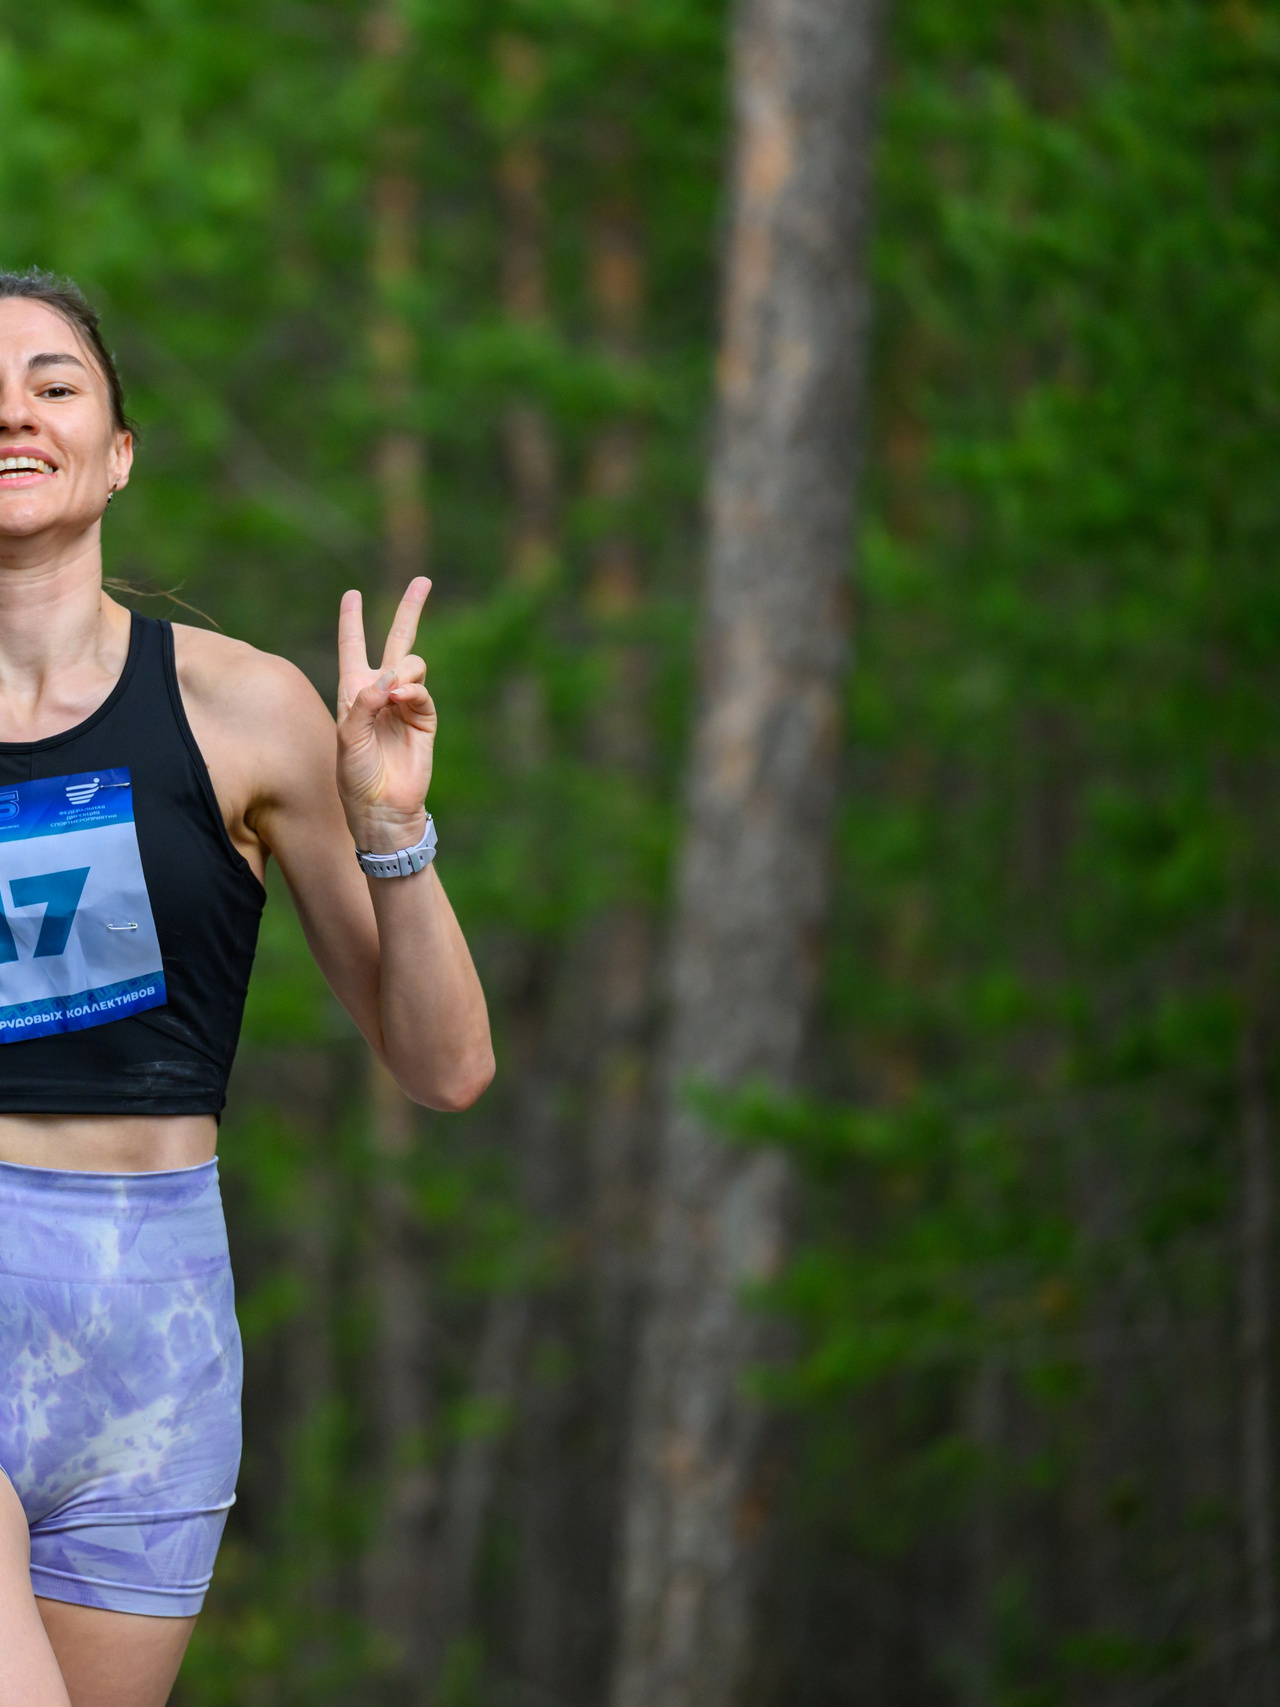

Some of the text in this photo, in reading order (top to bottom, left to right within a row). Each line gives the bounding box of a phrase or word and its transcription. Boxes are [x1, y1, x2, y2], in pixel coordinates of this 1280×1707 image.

[59, 805, 106, 816] ФЕДЕРАЛЬНАЯ
[66, 811, 100, 821] ДИРЕКЦИЯ
[66, 986, 156, 1019] КОЛЛЕКТИВОВ
